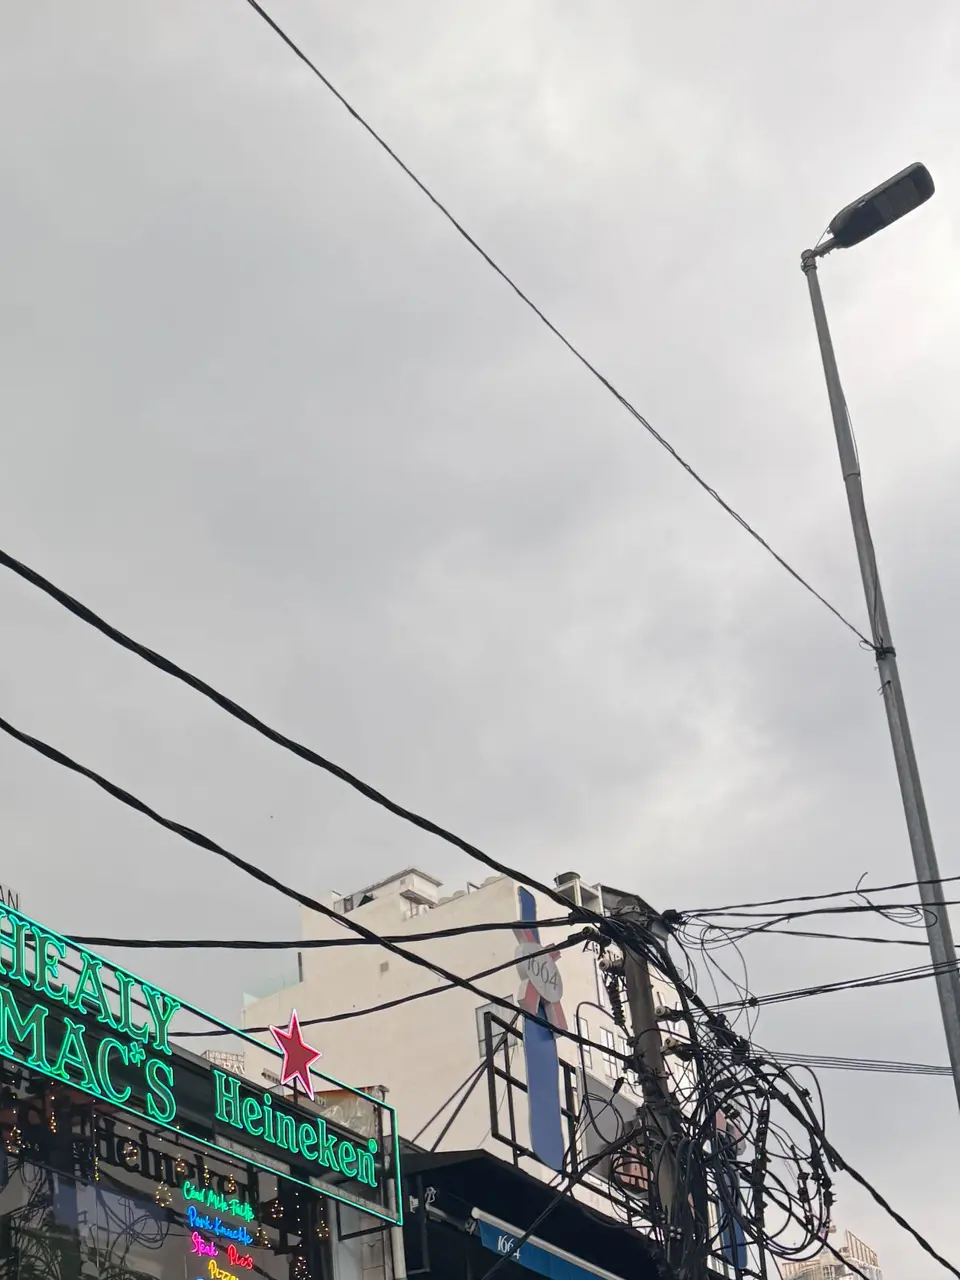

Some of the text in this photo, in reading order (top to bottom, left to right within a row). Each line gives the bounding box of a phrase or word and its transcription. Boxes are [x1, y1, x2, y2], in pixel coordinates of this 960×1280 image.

[526, 952, 559, 991] 1664
[213, 1068, 378, 1188] Heineken
[187, 1204, 253, 1246] Pork Knuckle
[190, 1231, 219, 1257] Steak
